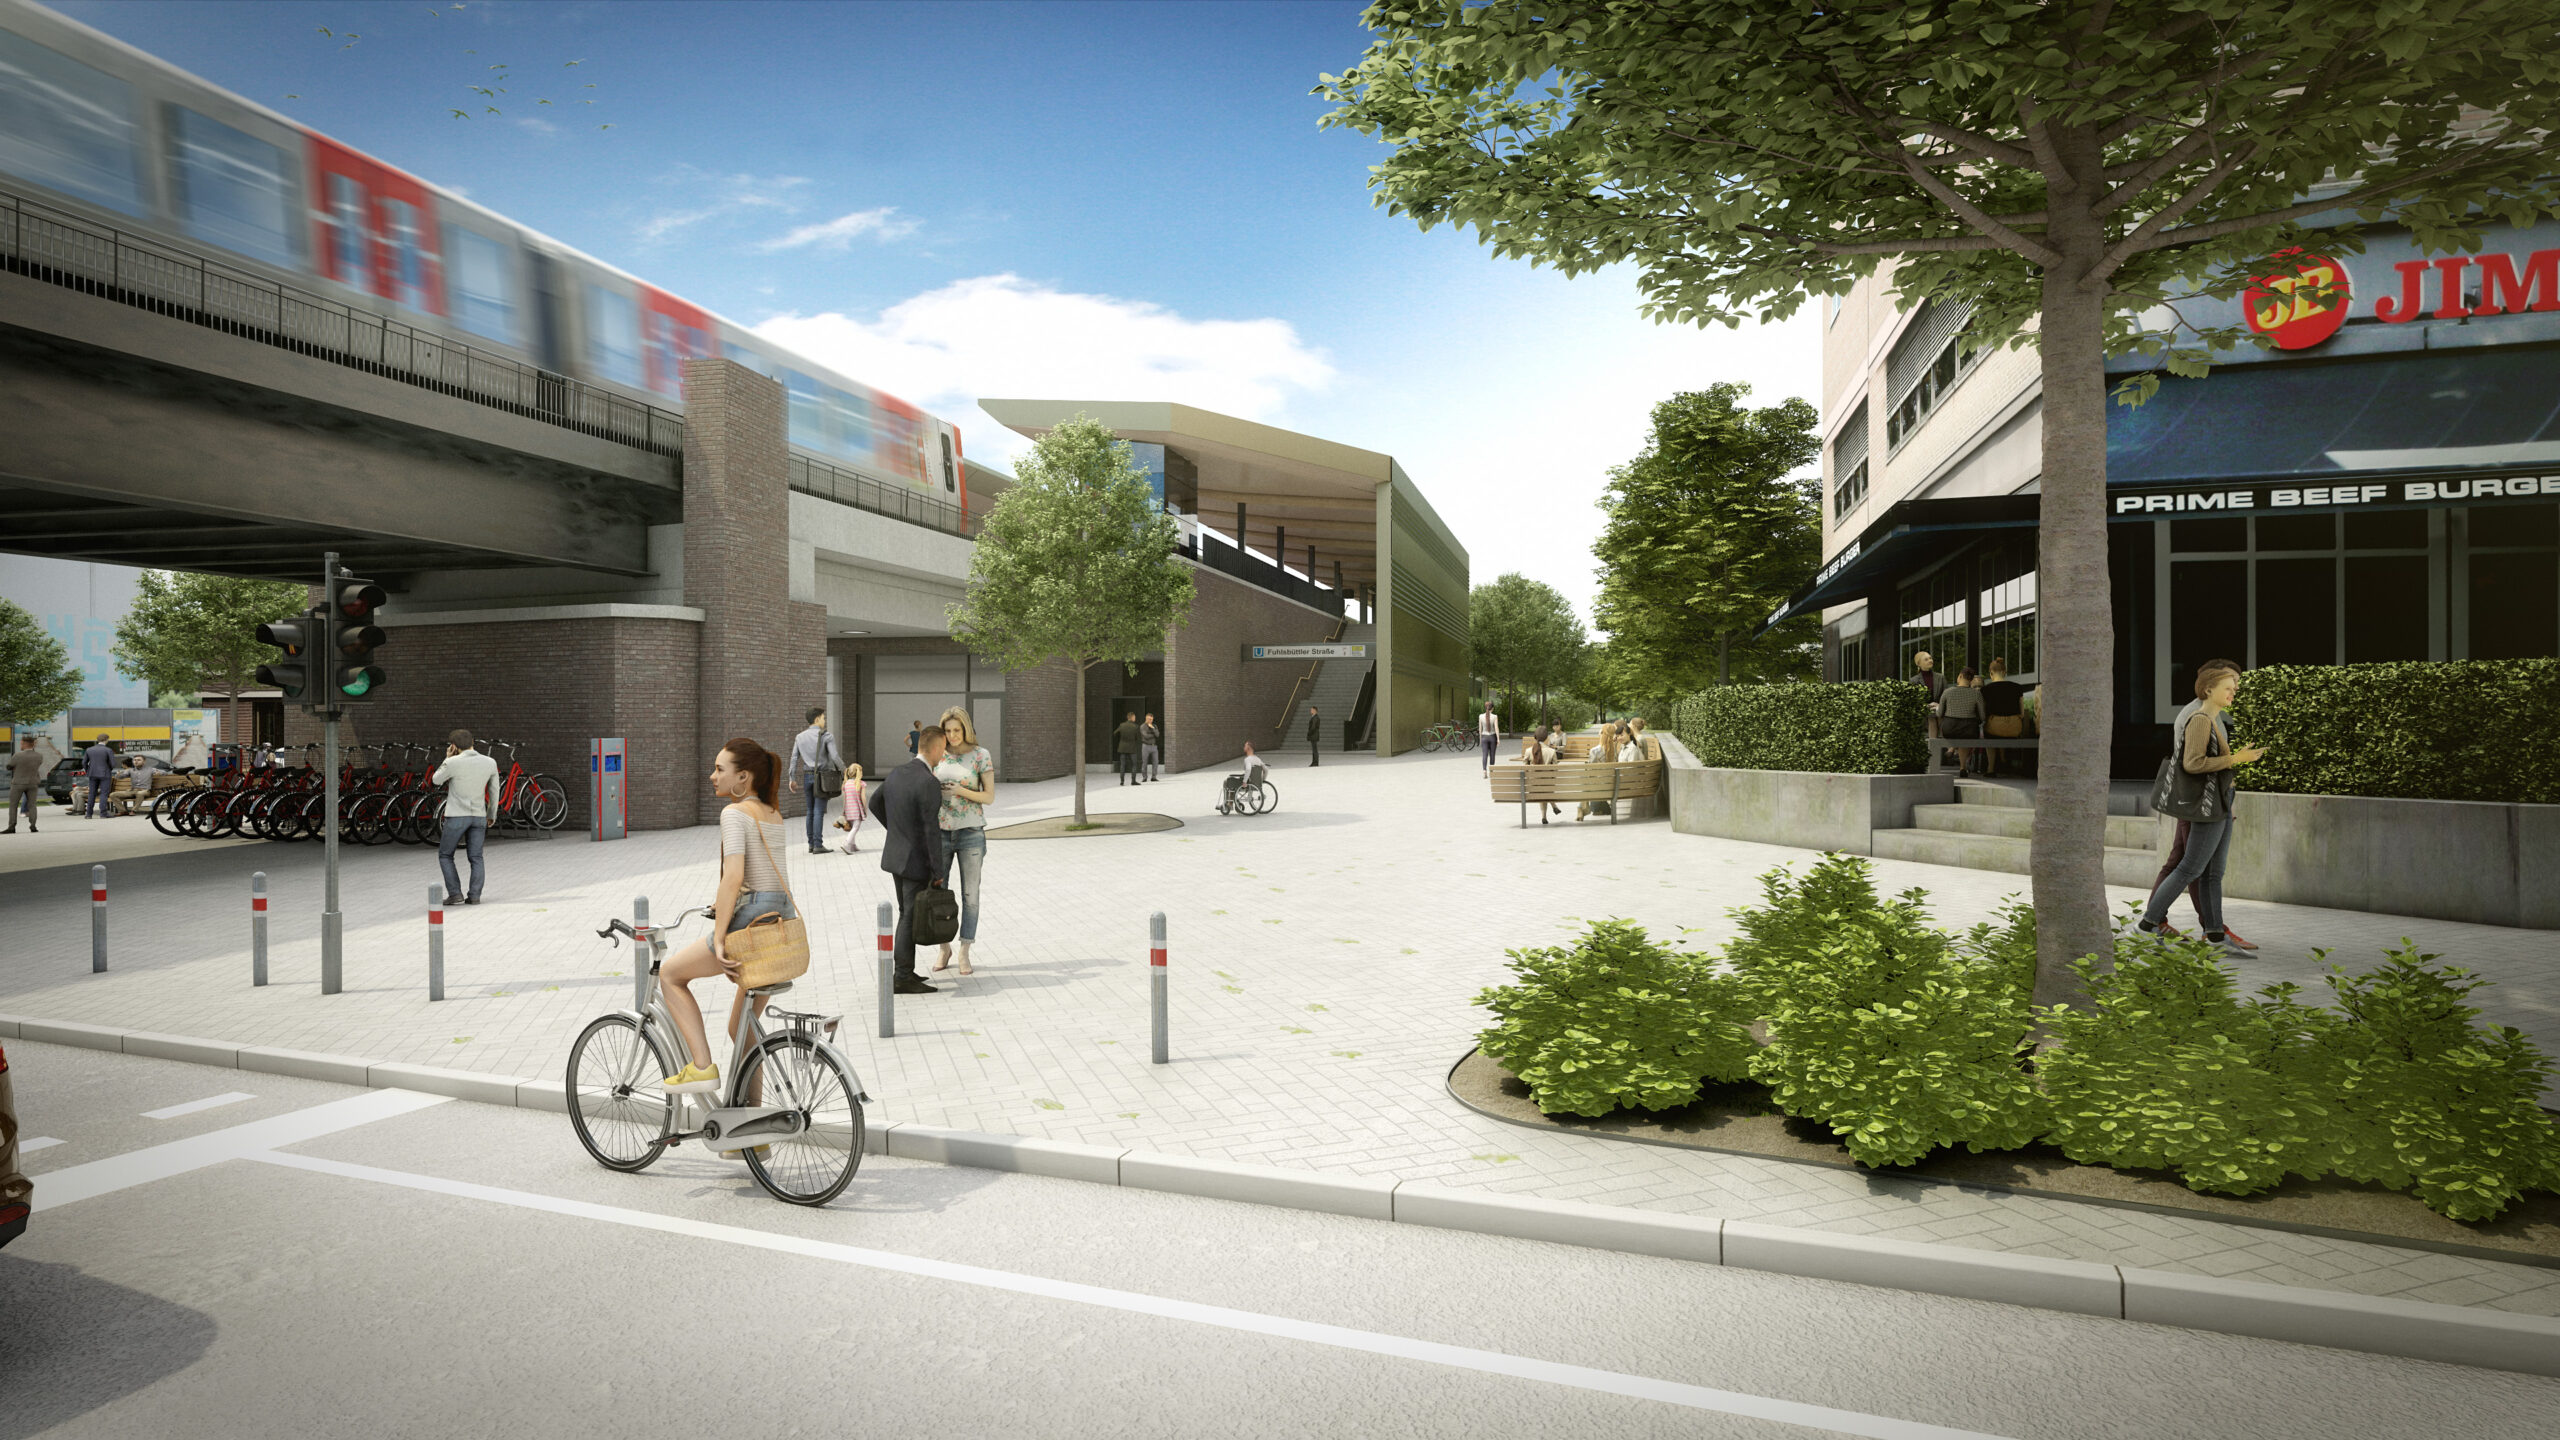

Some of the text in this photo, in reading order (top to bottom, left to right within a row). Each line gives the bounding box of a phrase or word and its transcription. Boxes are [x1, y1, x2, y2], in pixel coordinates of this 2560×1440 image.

[2374, 249, 2560, 324] JIM
[2116, 491, 2254, 513] PRIME
[2270, 485, 2387, 507] BEEF
[1267, 648, 1309, 656] Fuhlsbüttler
[1311, 647, 1335, 655] Straße
